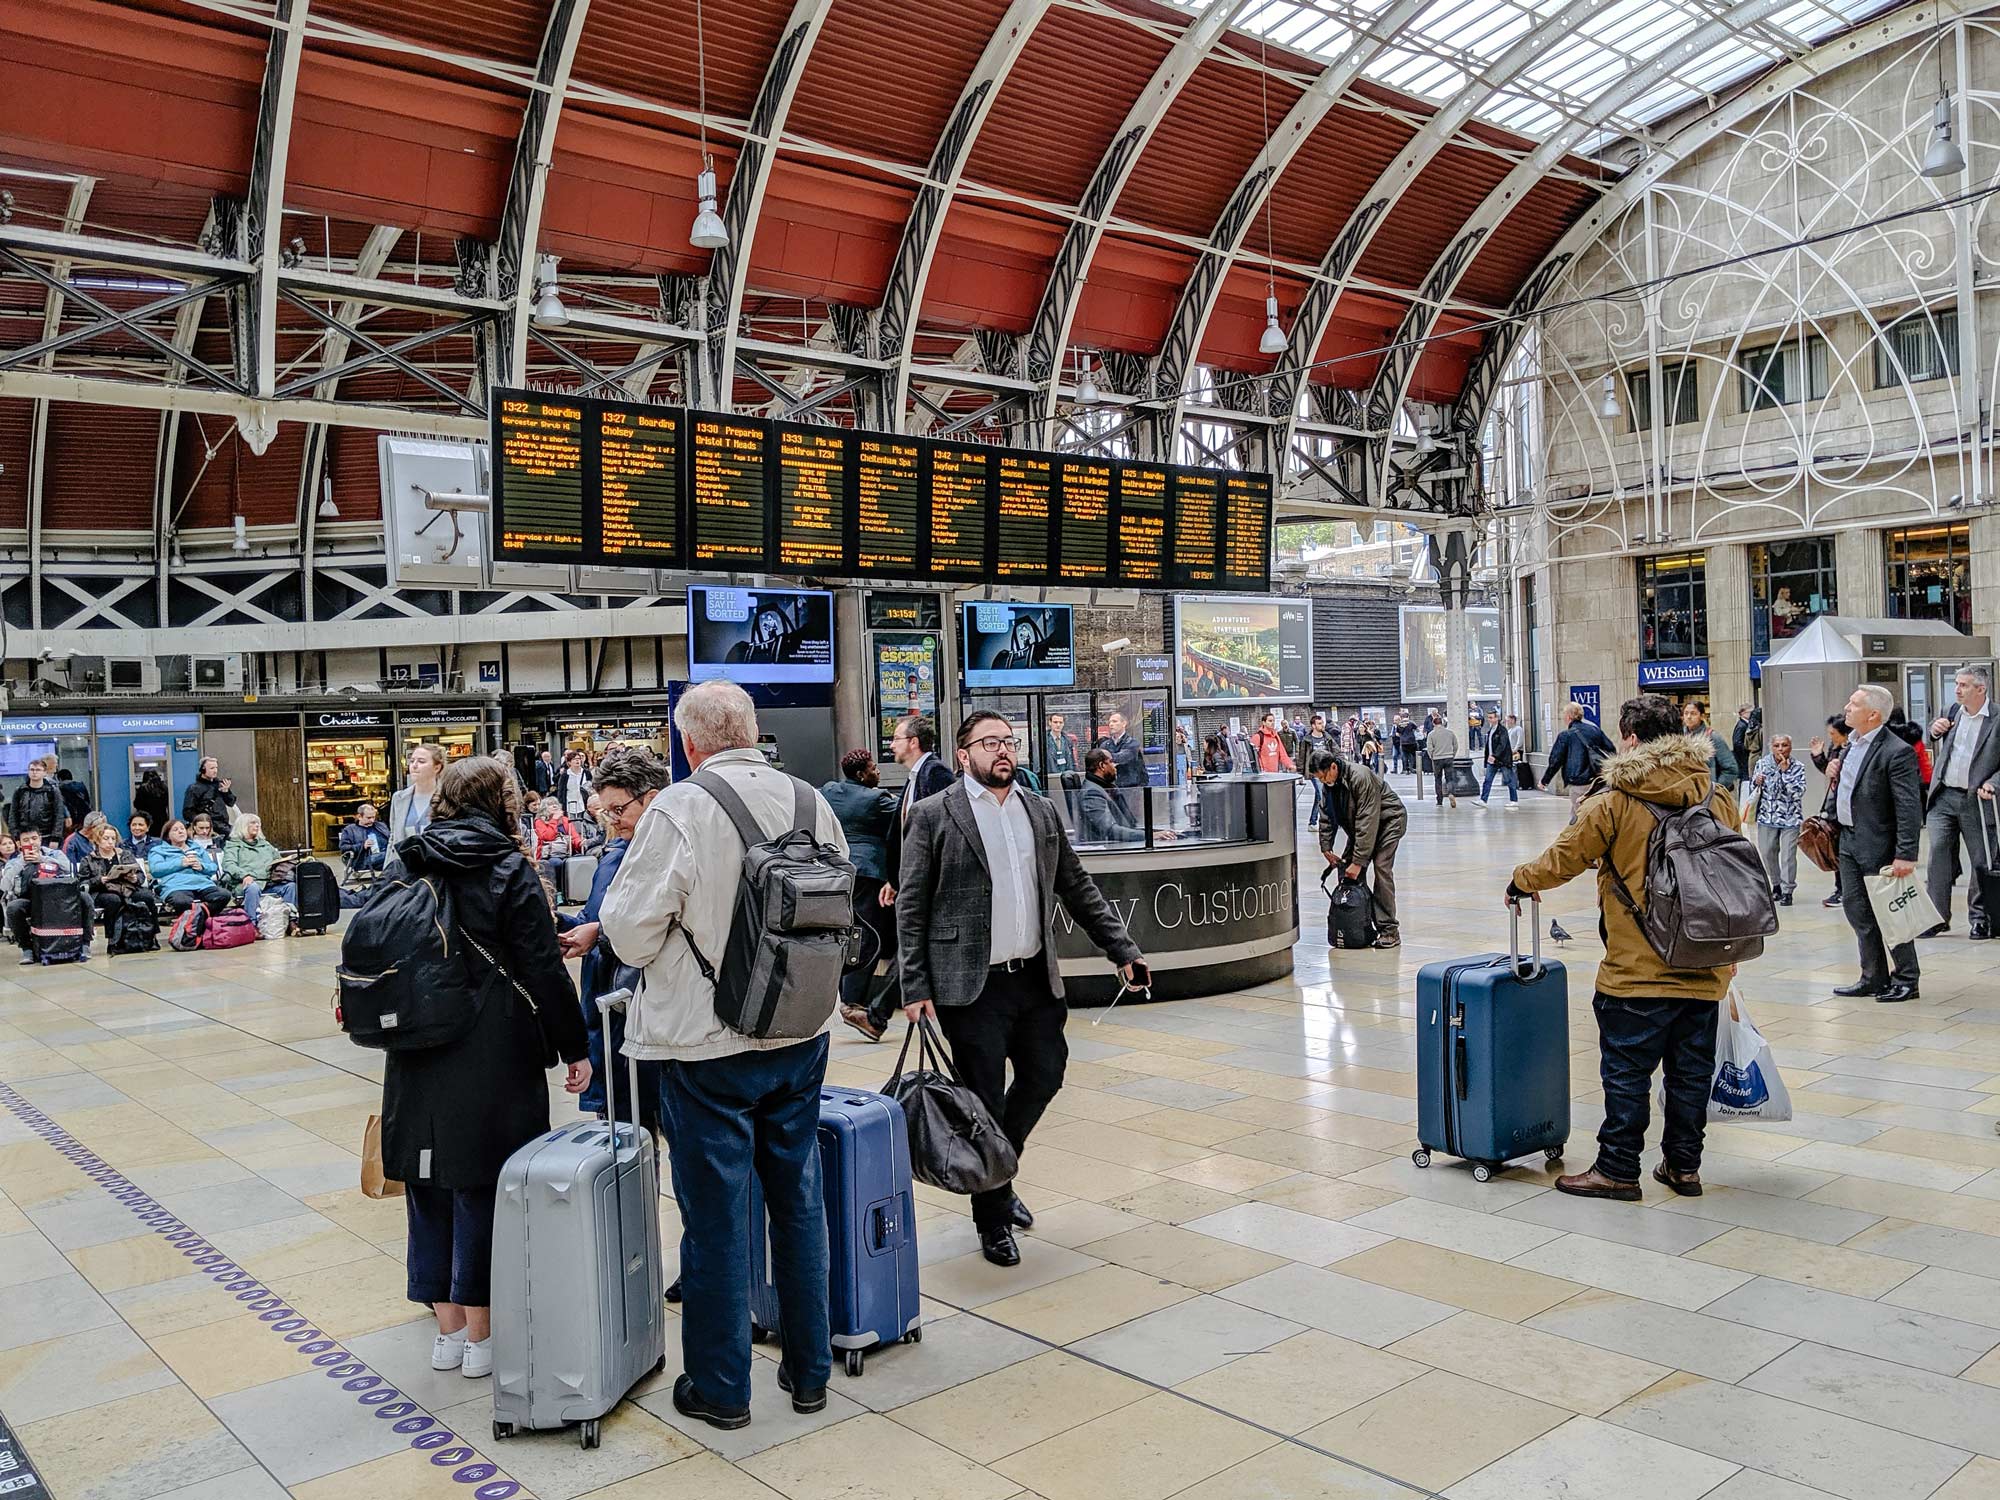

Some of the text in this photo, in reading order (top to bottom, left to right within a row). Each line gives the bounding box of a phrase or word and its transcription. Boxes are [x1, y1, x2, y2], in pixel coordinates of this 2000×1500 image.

[503, 402, 581, 419] 13:22 Boarding
[502, 417, 538, 426] Worcester
[603, 413, 675, 430] 13:27 Boarding
[602, 426, 633, 438] Cholsey
[697, 423, 763, 439] 13:30 Preparing
[696, 435, 756, 450] Bristol T Meads
[782, 433, 843, 448] 13:33 Pls wait
[506, 441, 579, 452] platform, passengers
[781, 445, 835, 458] Heathrow T234
[520, 450, 555, 459] Charlbury
[602, 449, 655, 460] Ealing Broadway
[630, 460, 664, 468] Harlington
[861, 454, 911, 467] Cheltenham Spa
[933, 461, 959, 471] Twyford
[620, 467, 645, 475] Drayton
[603, 481, 628, 490] Langley
[603, 498, 639, 506] Maidenhead
[603, 514, 628, 522] Reading
[603, 522, 633, 530] Tilehurst
[603, 530, 640, 538] Pangbourne
[709, 592, 736, 600] SEE IT.
[709, 600, 736, 609] SAY IT.
[881, 652, 931, 666] escape
[1136, 658, 1168, 670] Paddington
[393, 668, 407, 680] 12
[481, 665, 497, 677] 14
[1142, 671, 1163, 680] Station
[1643, 666, 1704, 679] WHSmith
[1573, 691, 1598, 703] WH
[1718, 1107, 1735, 1116] Join
